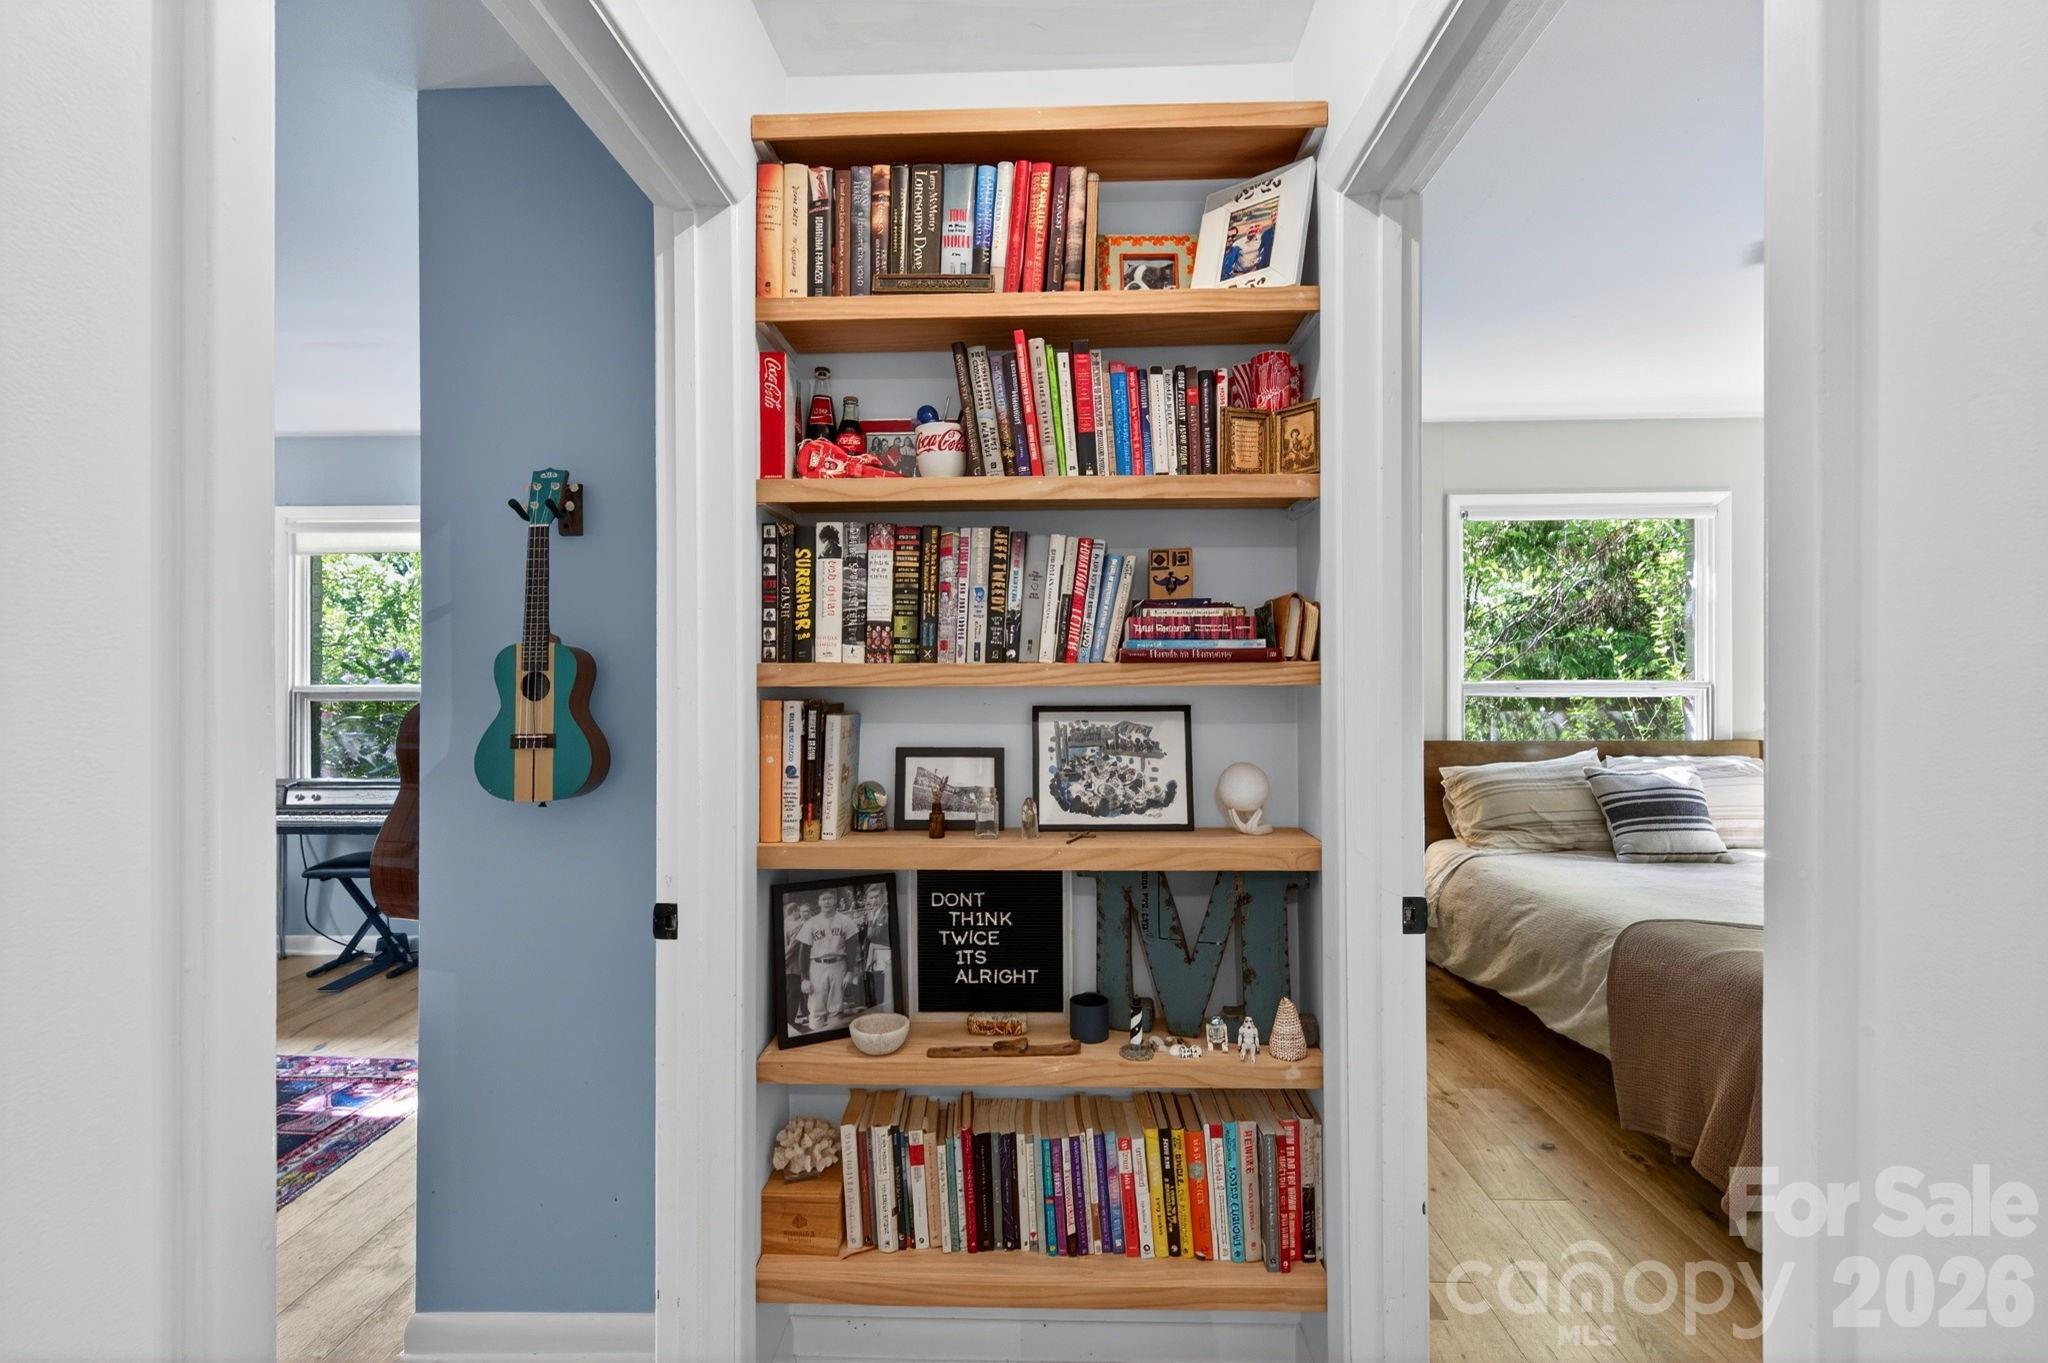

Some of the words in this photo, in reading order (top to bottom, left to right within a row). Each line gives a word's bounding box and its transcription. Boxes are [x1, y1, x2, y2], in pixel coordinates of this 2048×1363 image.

[928, 169, 938, 190] Larry
[913, 170, 928, 234] Lonesome
[913, 237, 927, 270] Dove
[992, 530, 1008, 561] JEFF
[827, 560, 837, 580] bob
[1074, 541, 1091, 597] JONATHAN
[780, 585, 790, 618] CASH
[795, 548, 812, 631] SURRENDER
[825, 586, 837, 617] dylan
[990, 563, 1007, 614] TWEEDY
[931, 892, 985, 907] DONT
[939, 930, 1000, 946] TWICE
[955, 968, 1039, 984] ALRIGHT
[1244, 1130, 1254, 1174] REWIRE
